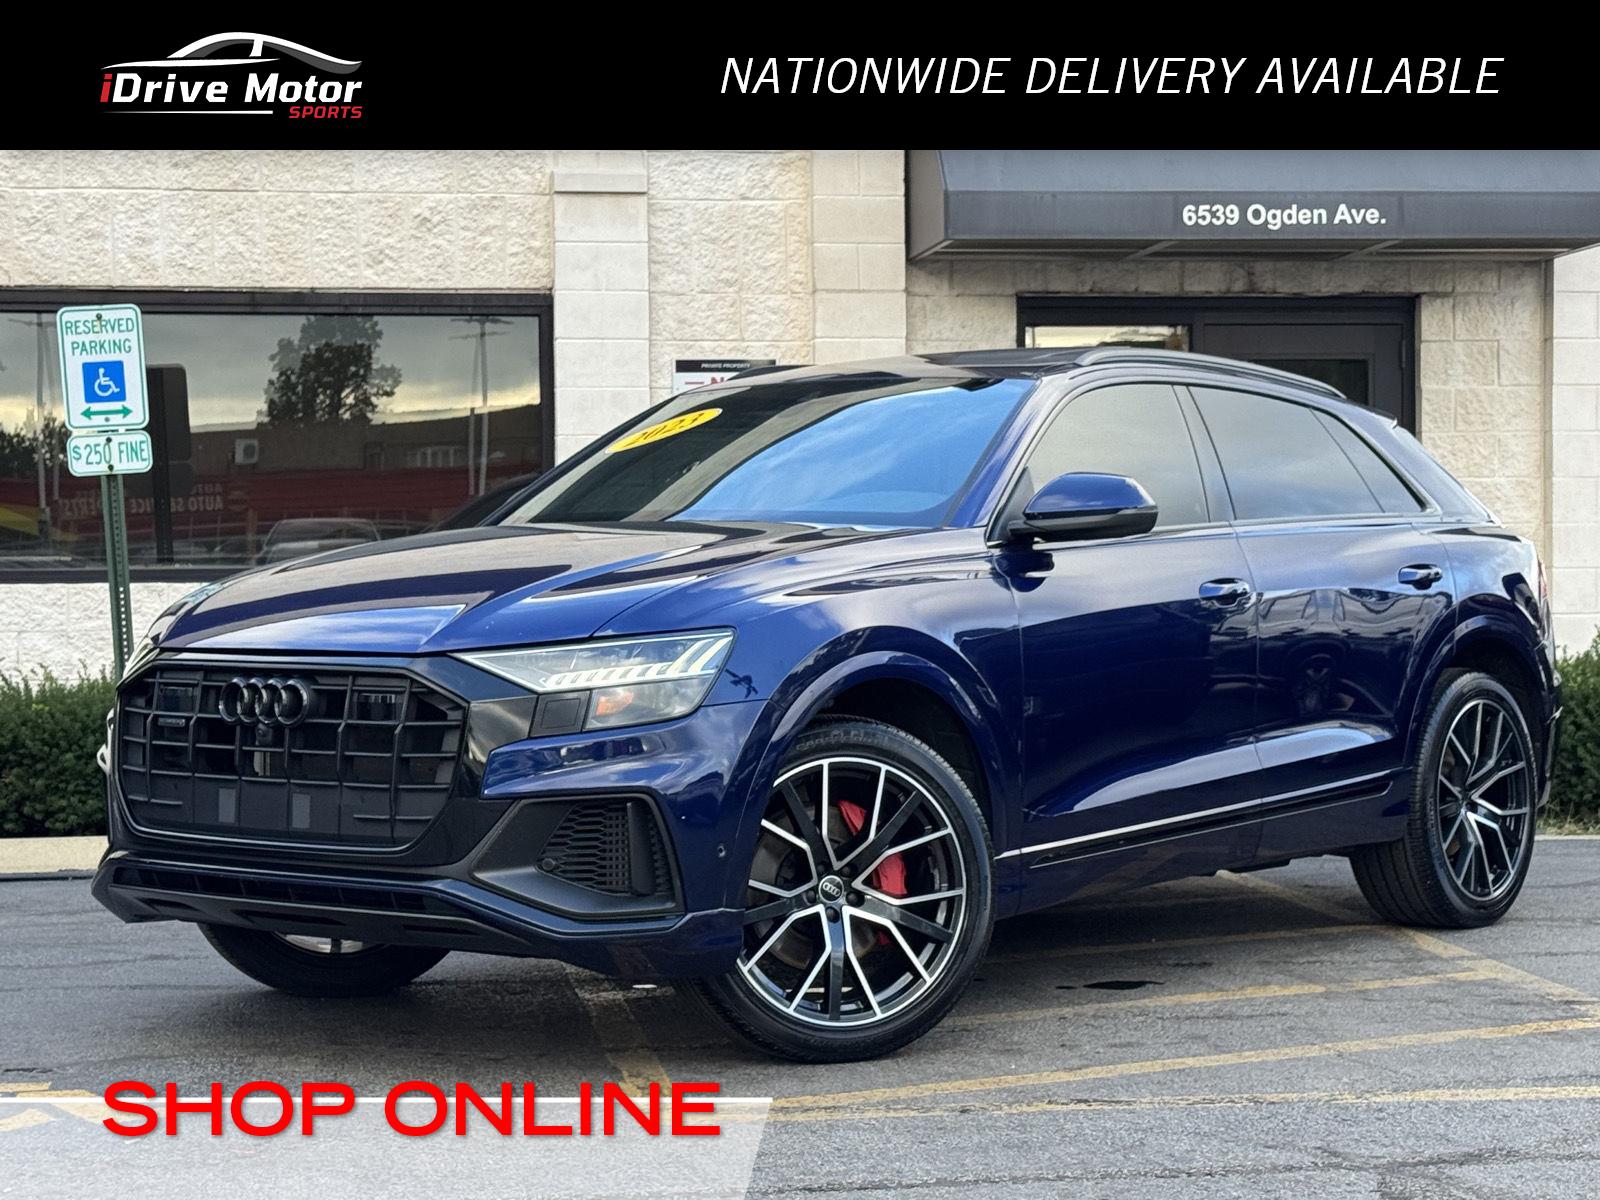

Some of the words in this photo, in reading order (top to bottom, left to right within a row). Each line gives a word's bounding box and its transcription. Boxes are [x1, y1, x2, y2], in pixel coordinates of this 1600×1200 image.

[1182, 204, 1240, 226] 6539
[1246, 203, 1328, 231] Ogden
[1333, 203, 1387, 225] Ave.
[64, 317, 135, 336] RESERVED
[70, 338, 132, 356] PARKING
[72, 443, 112, 465] $250
[117, 440, 149, 463] FINE
